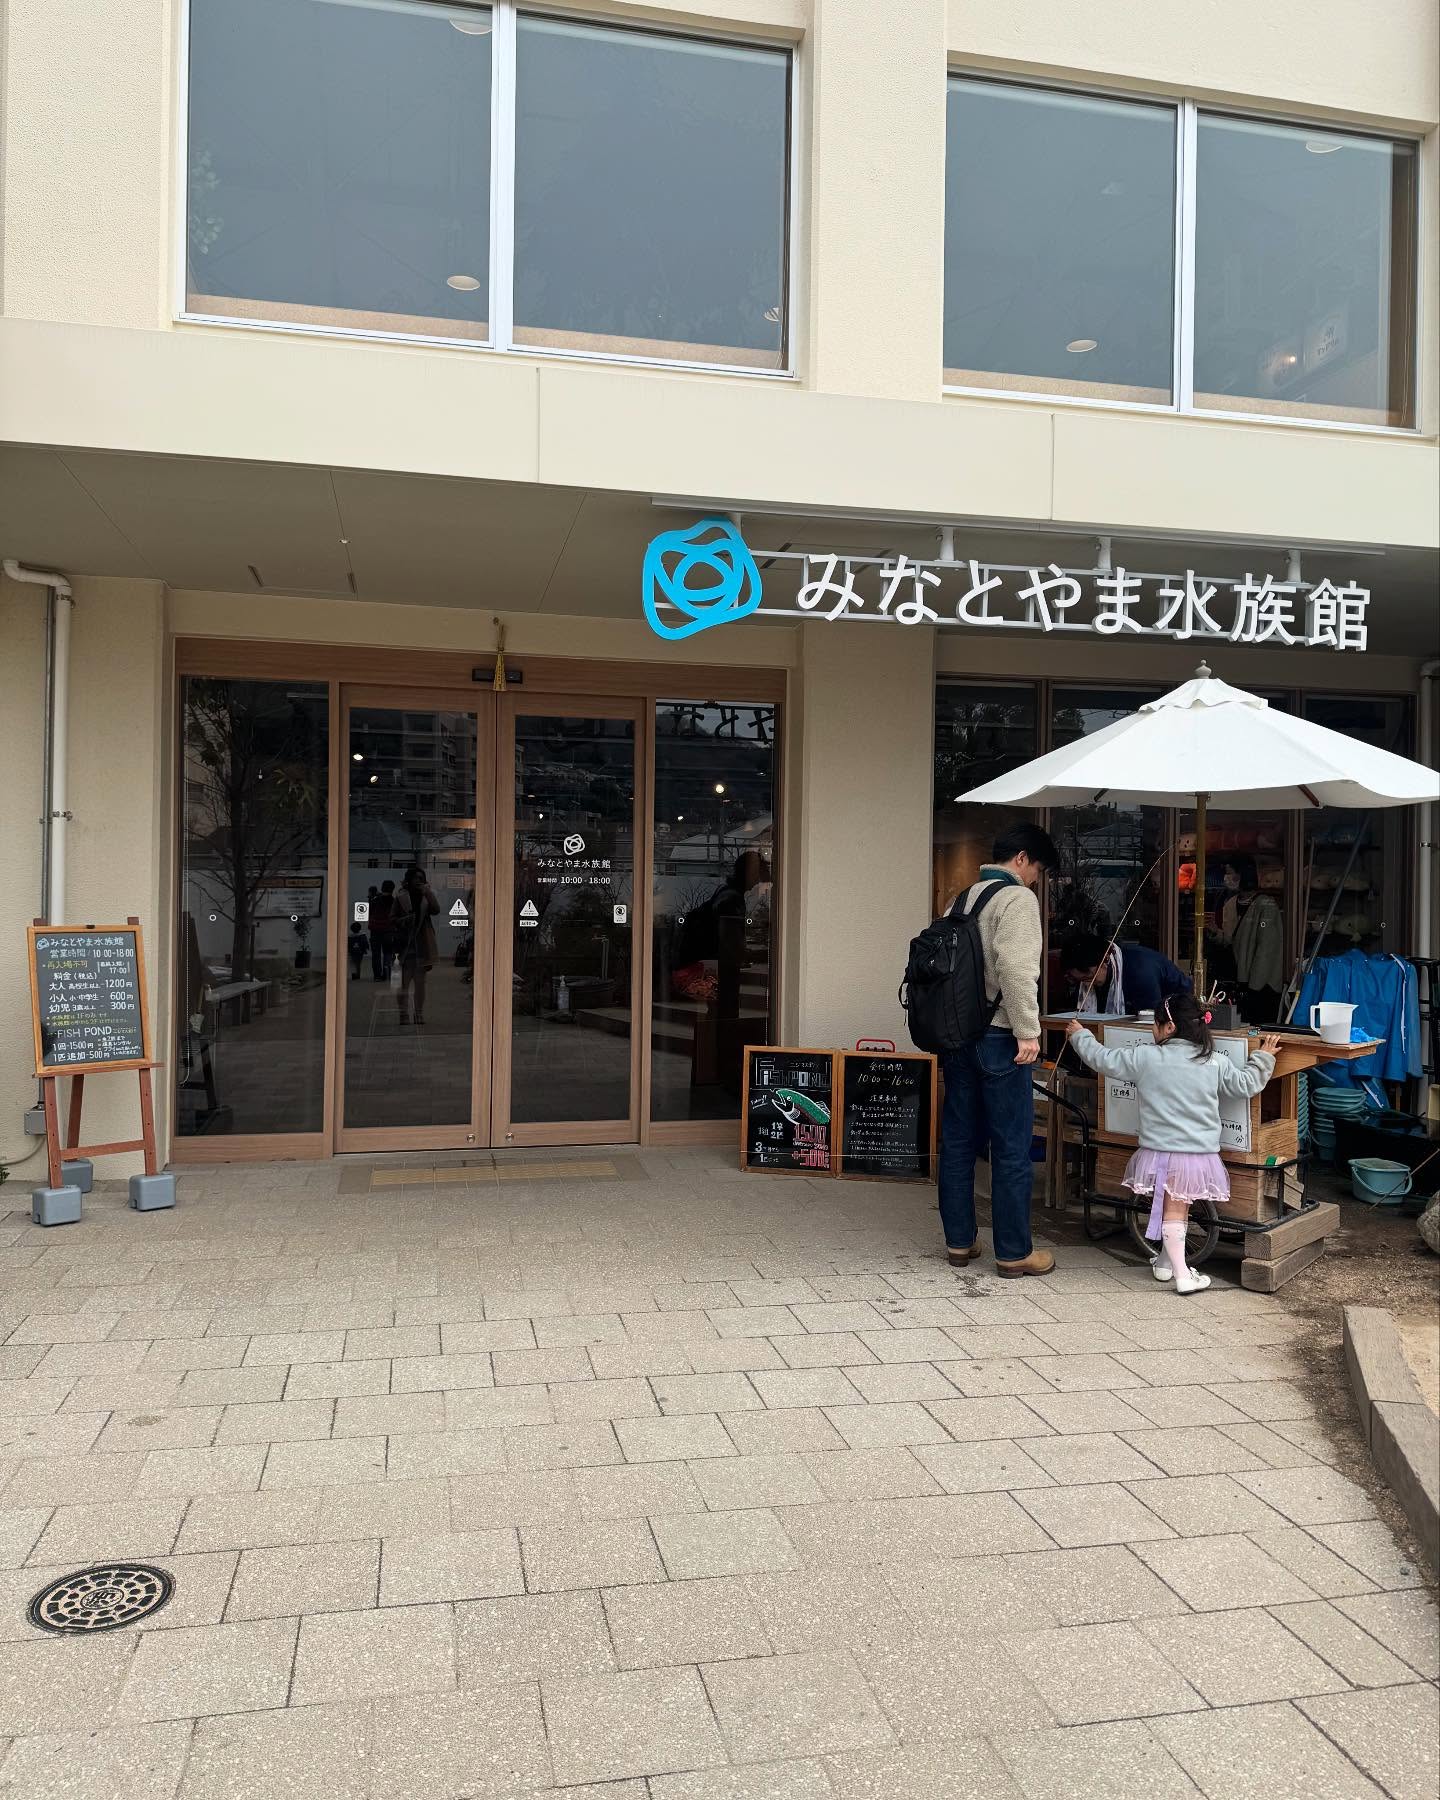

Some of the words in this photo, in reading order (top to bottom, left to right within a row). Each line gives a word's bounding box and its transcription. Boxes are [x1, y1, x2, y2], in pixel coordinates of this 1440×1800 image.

[797, 553, 1372, 652] みなとやま水族館
[537, 859, 611, 869] みなとやま水族館
[560, 876, 582, 884] 10:00
[50, 937, 124, 947] みなとやま水族館
[49, 982, 66, 991] 大人
[49, 993, 67, 1002] 小人
[49, 1003, 70, 1013] 幼児
[57, 1028, 80, 1039] FISH
[84, 1026, 112, 1036] POND
